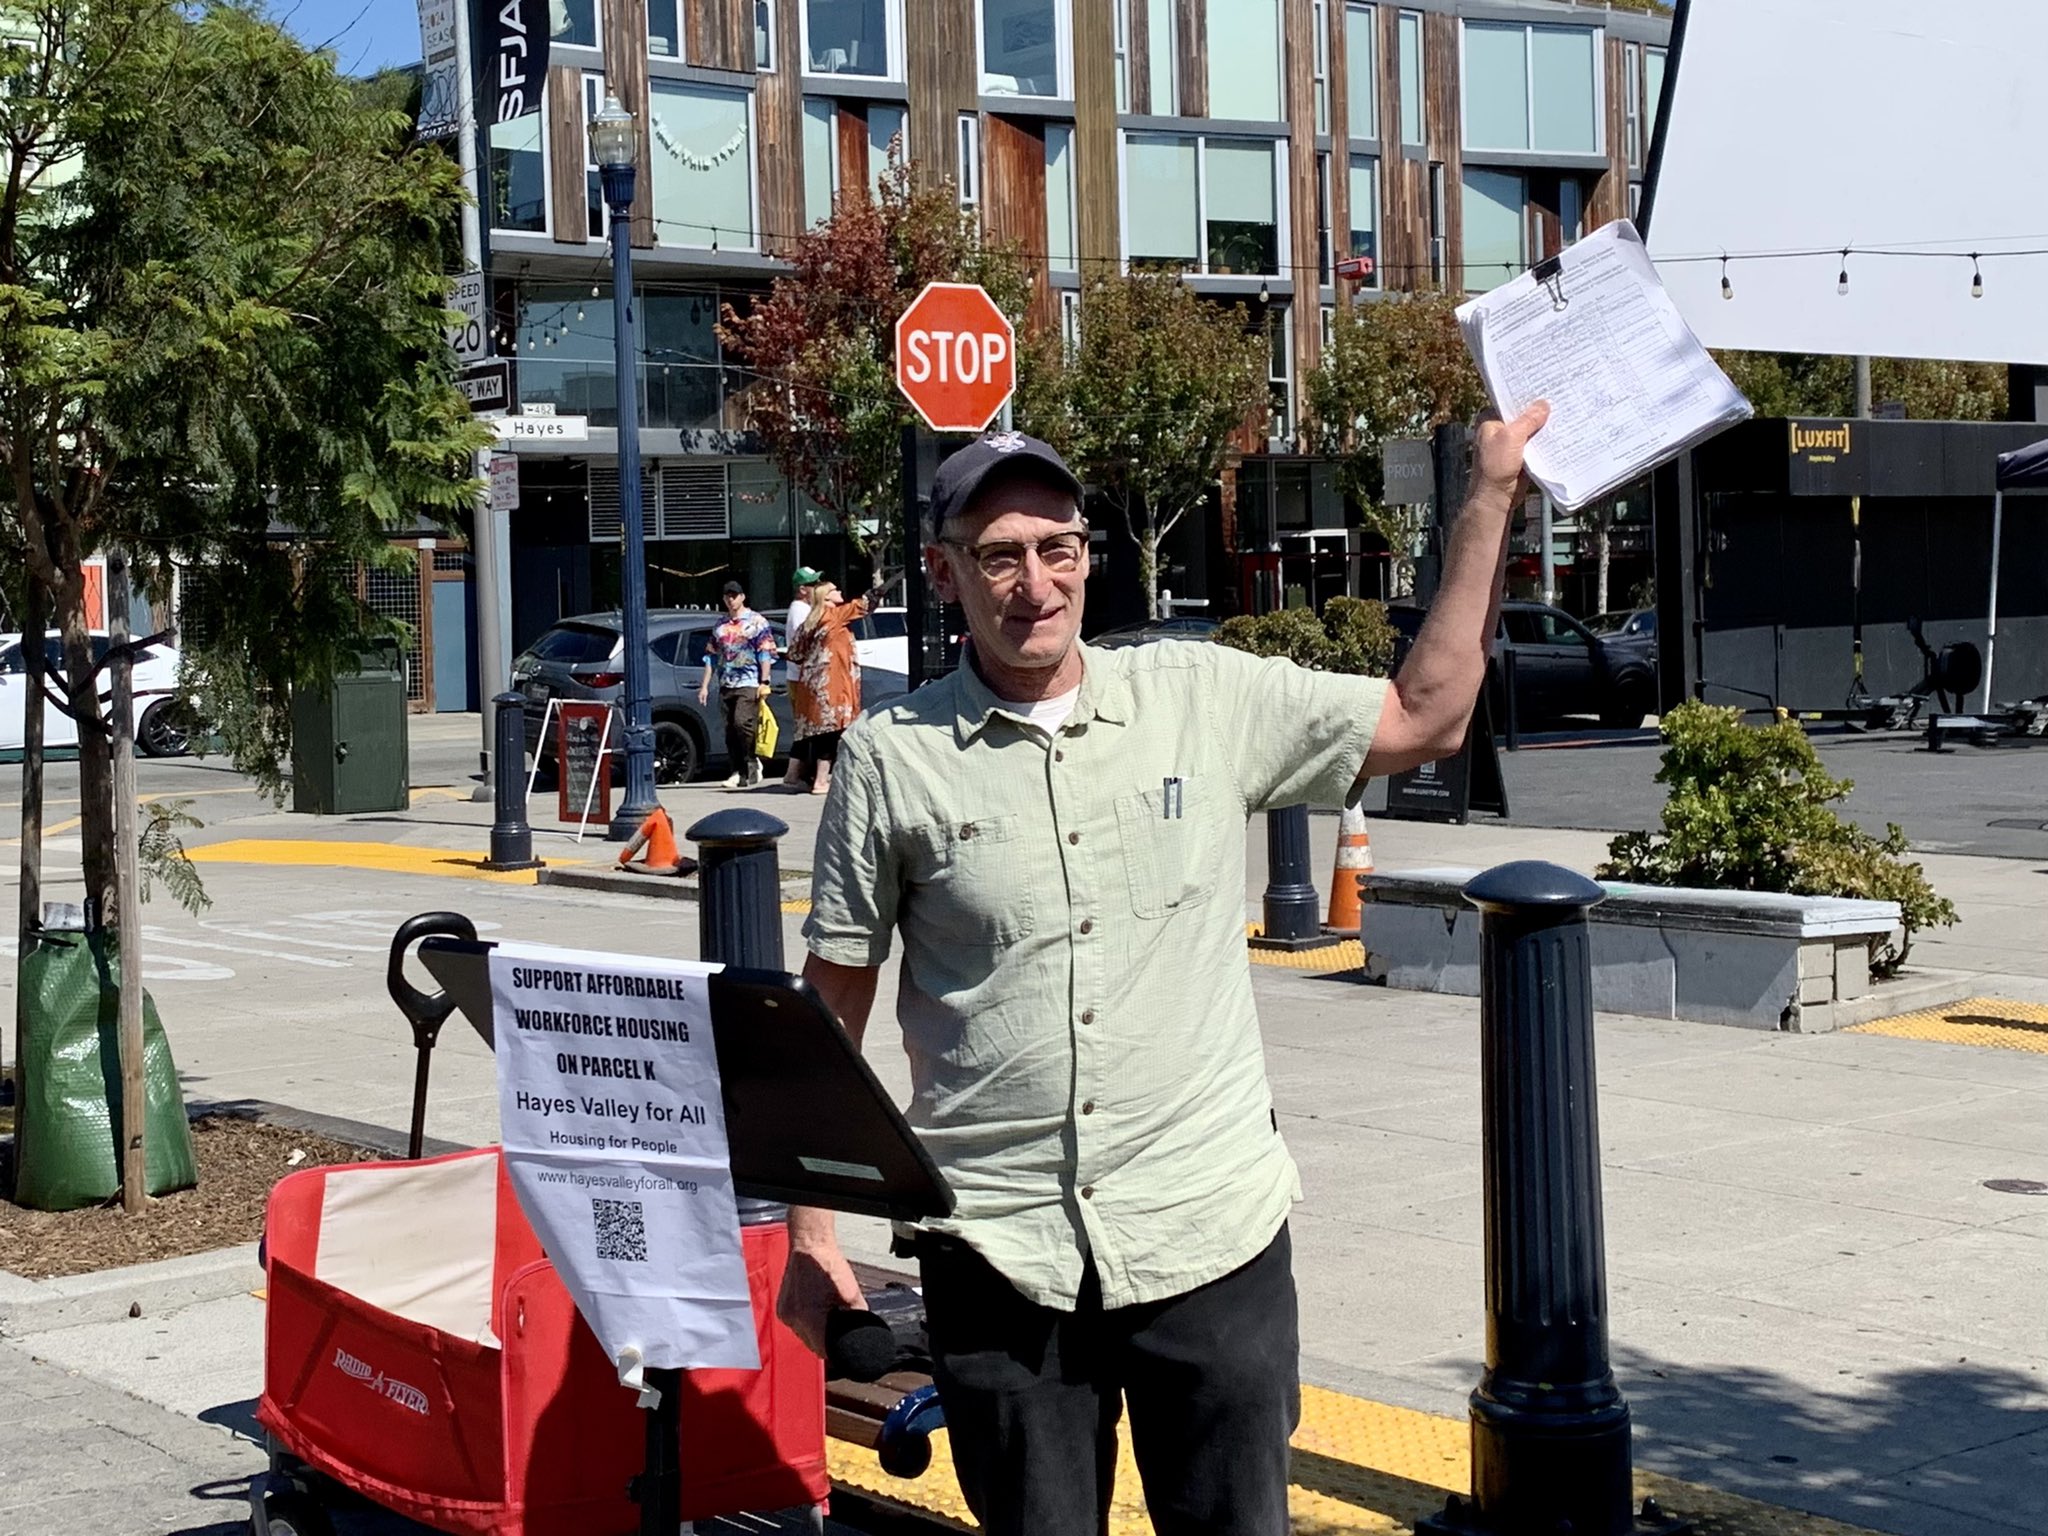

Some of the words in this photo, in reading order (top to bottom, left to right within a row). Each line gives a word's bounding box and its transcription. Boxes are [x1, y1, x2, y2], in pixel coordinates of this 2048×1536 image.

[448, 283, 480, 301] SPEED
[452, 302, 477, 315] IMIT
[453, 320, 480, 353] 20
[906, 329, 1006, 384] STOP
[476, 377, 499, 398] WAY
[514, 421, 564, 437] Hayes
[1387, 464, 1425, 479] PROXY
[513, 967, 582, 992] SUPPORT
[587, 973, 685, 1001] AFFORDABLE
[515, 1008, 613, 1037] WORKFORCE
[616, 1016, 689, 1042] HOUSING
[557, 1053, 578, 1075] ON
[582, 1056, 641, 1080] PARCEL
[643, 1060, 656, 1081] K
[517, 1091, 575, 1117] Hayes
[580, 1096, 639, 1124] Valley
[646, 1101, 673, 1122] for
[679, 1105, 706, 1125] All
[550, 1130, 605, 1150] Housing
[608, 1134, 627, 1149] for
[632, 1137, 677, 1155] People
[537, 1171, 698, 1195] www.hayesvalleyforall.org
[332, 1347, 373, 1379] RADIO
[384, 1378, 429, 1414] FLYER
